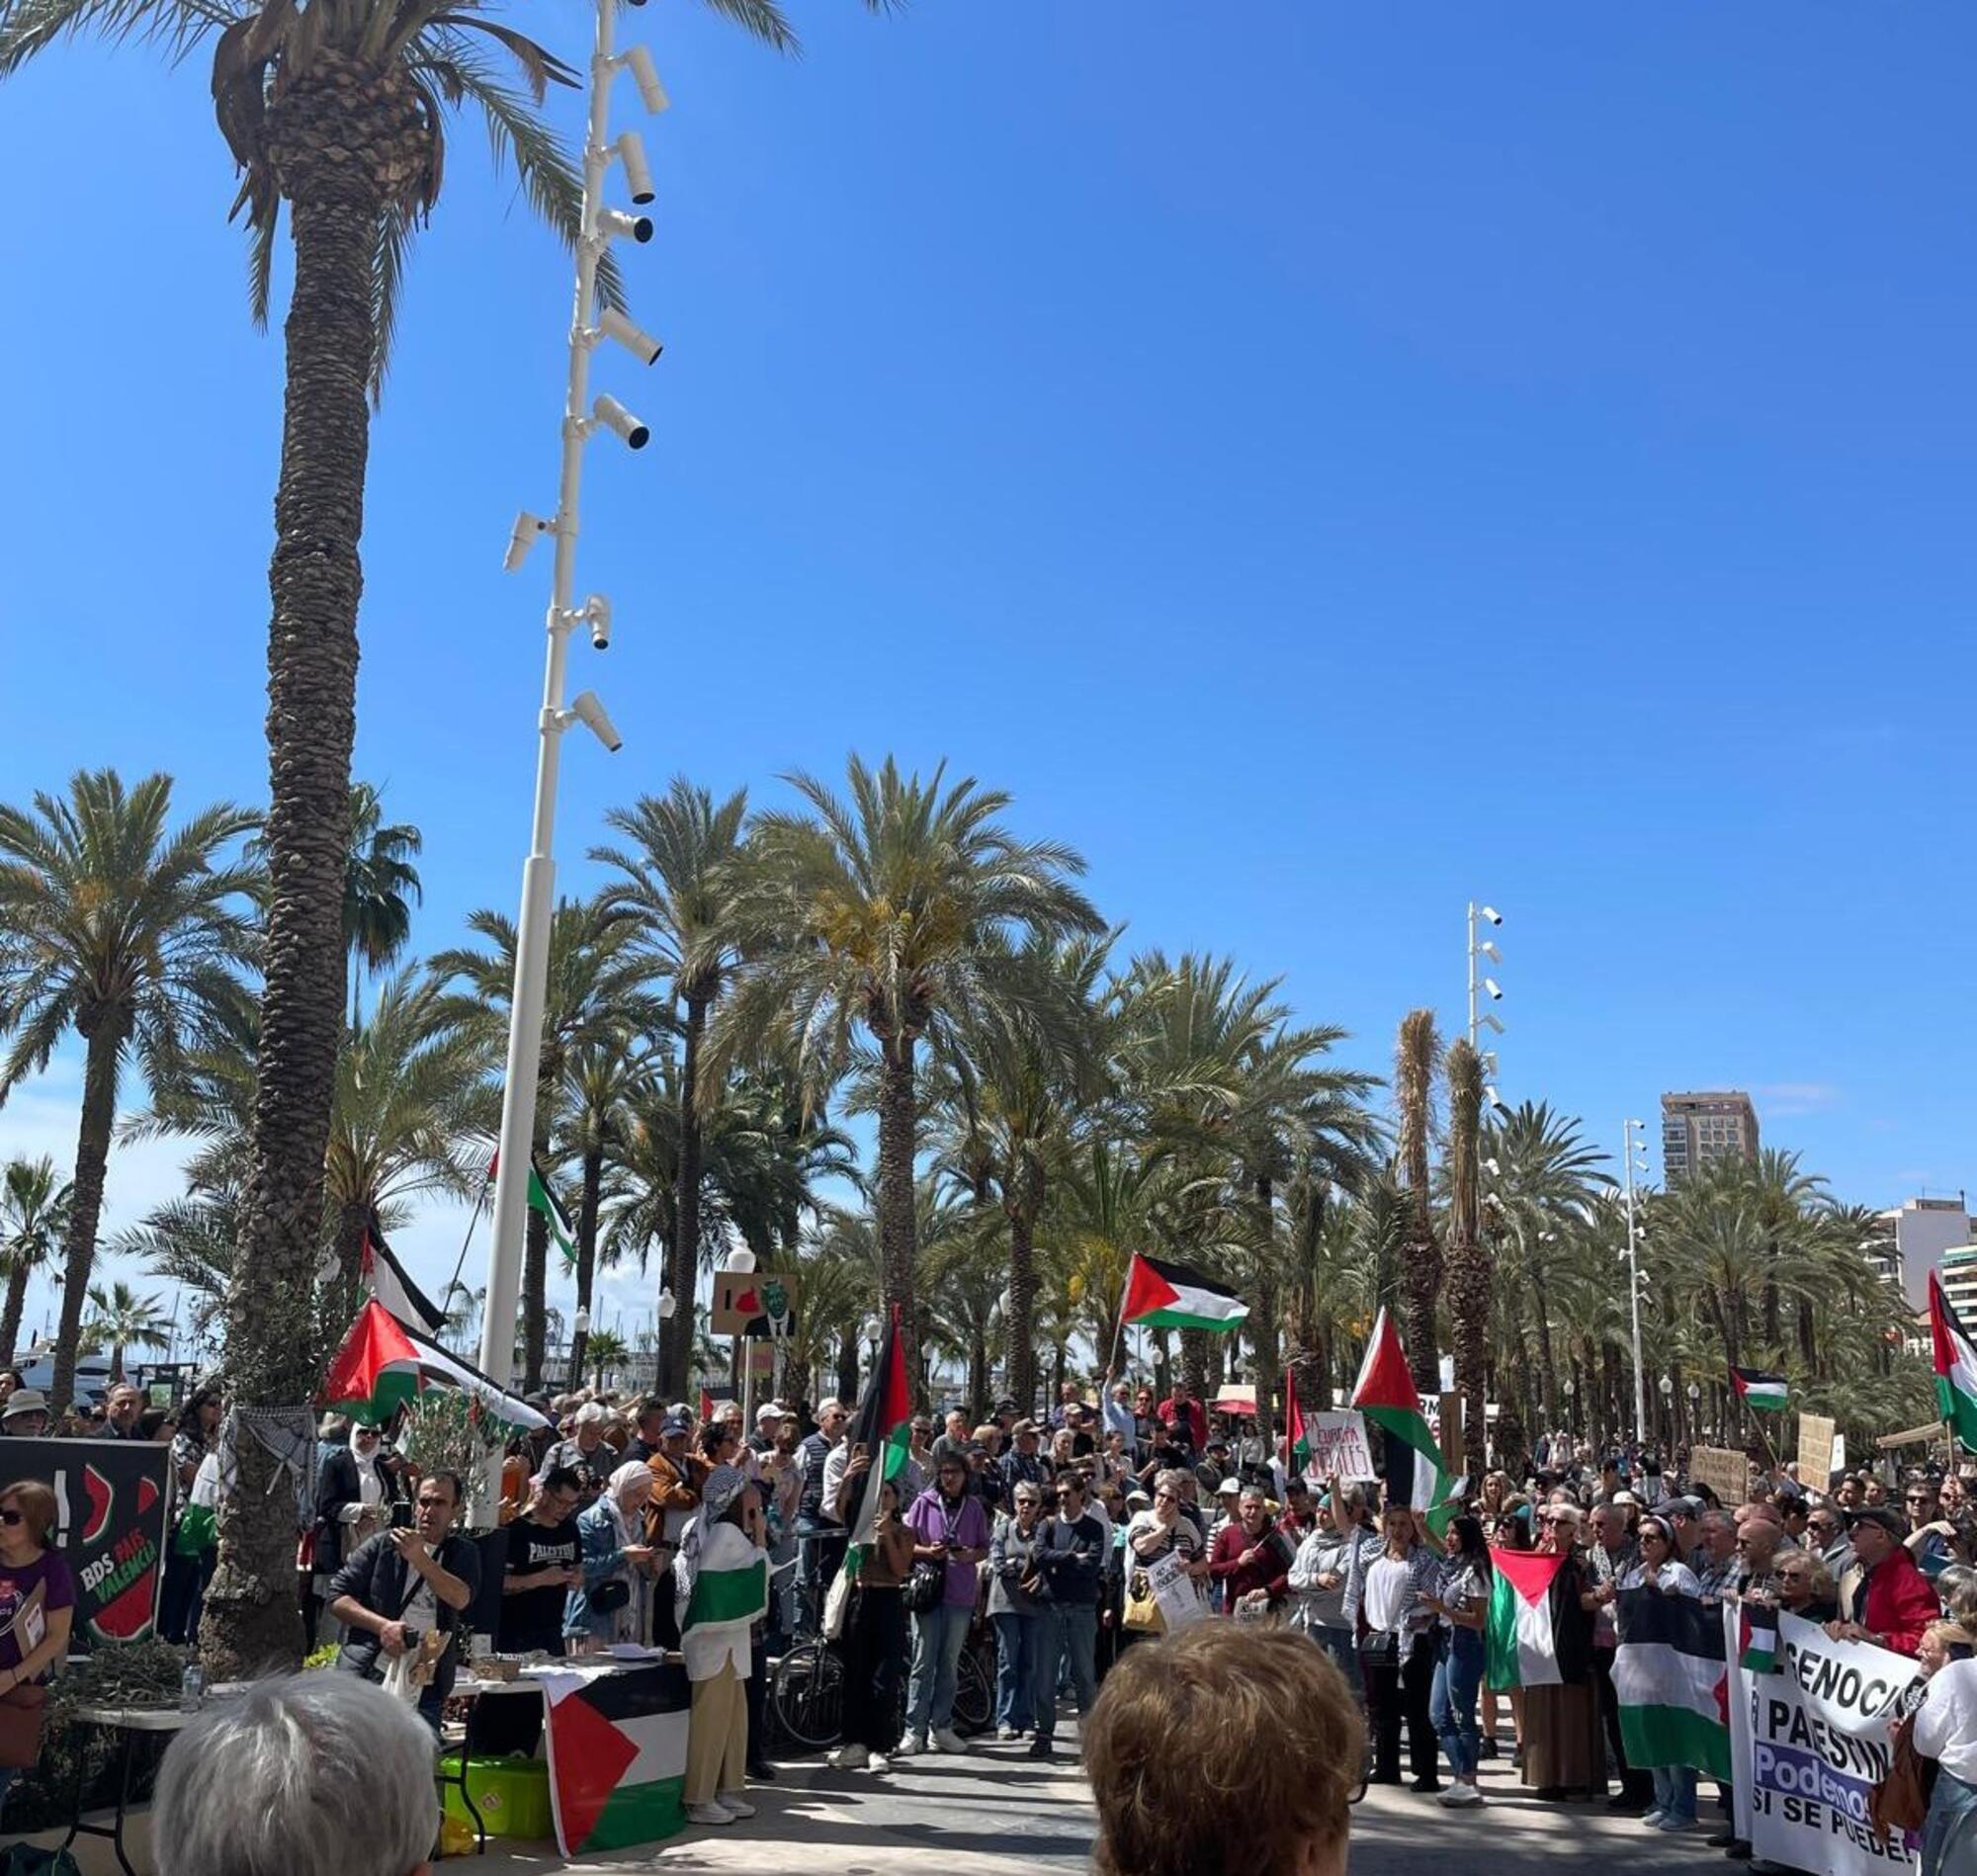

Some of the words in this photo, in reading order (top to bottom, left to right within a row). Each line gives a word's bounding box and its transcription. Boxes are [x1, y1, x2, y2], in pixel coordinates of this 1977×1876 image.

[80, 1552, 115, 1592] BDS
[1754, 1786, 1771, 1816] SI
[1783, 1797, 1822, 1829] SE
